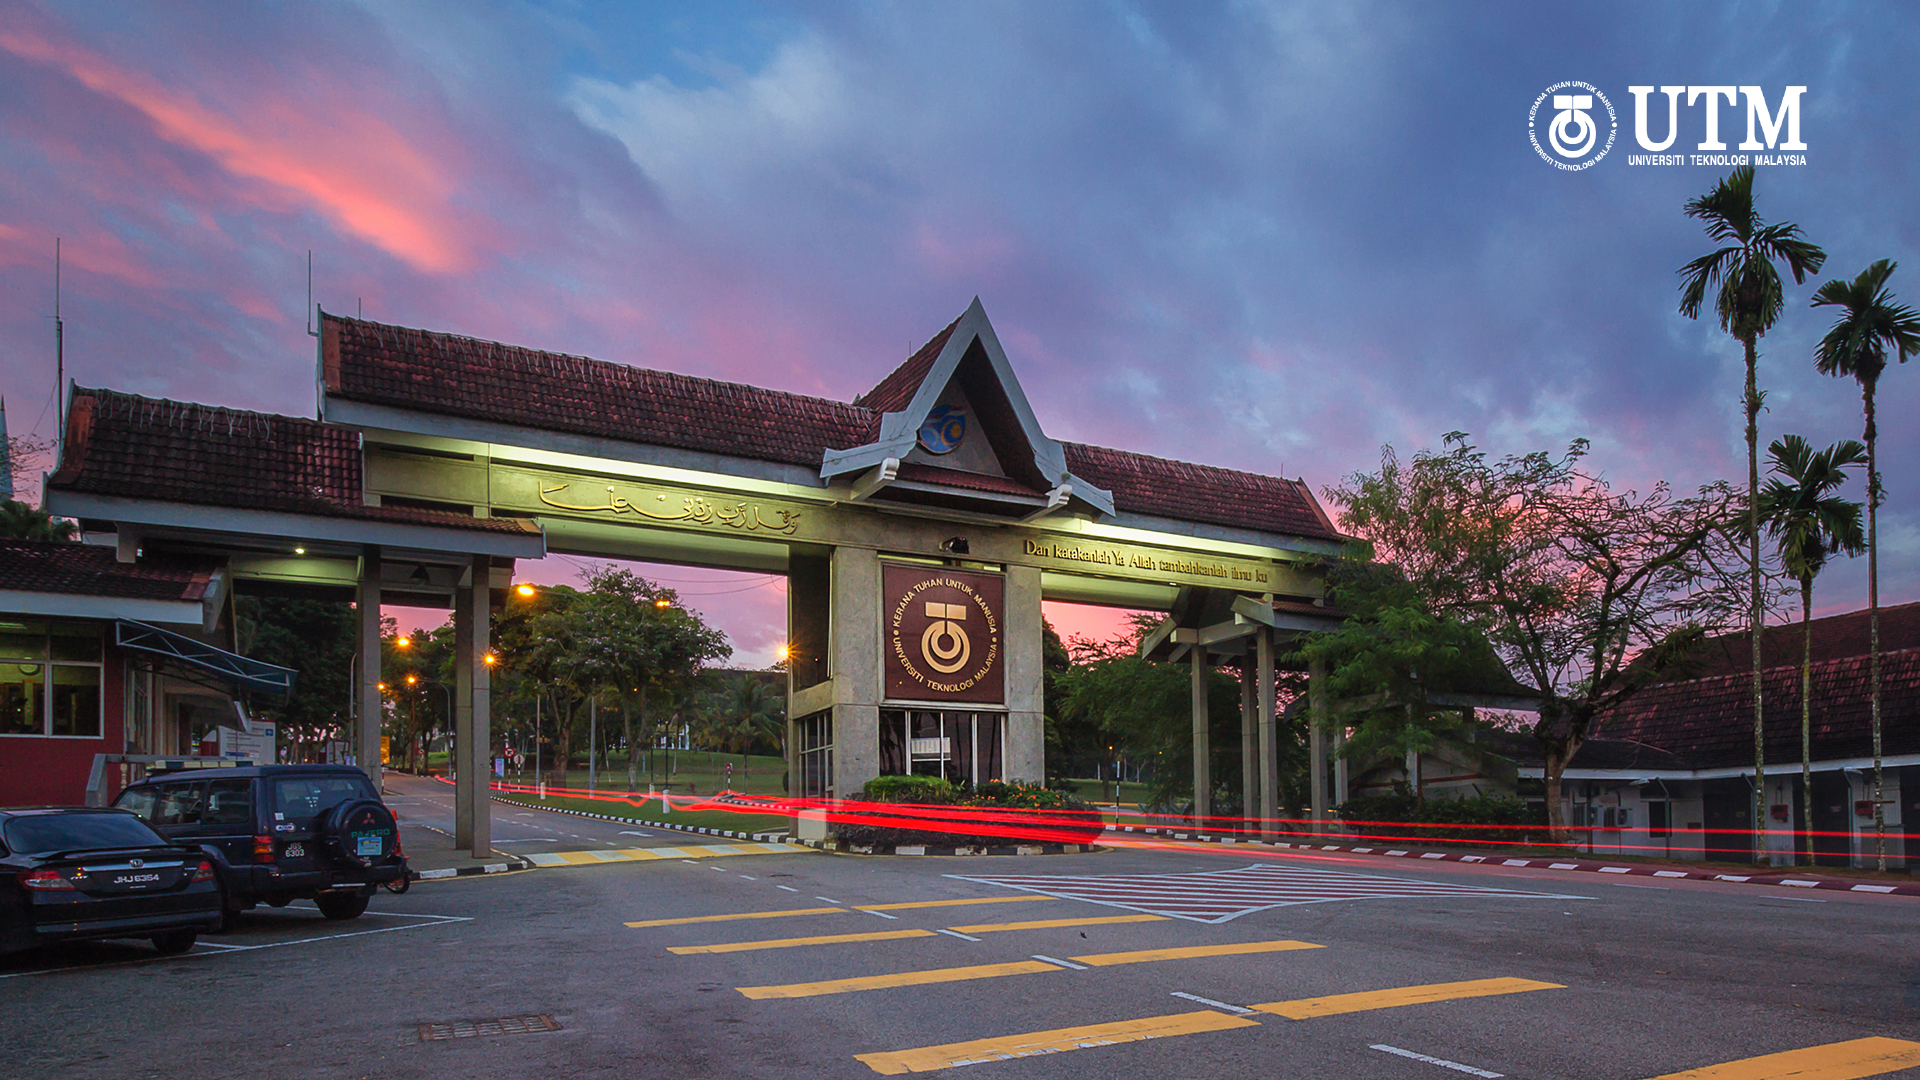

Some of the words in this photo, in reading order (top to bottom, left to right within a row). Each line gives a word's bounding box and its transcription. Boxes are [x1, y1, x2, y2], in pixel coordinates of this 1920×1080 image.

[1026, 540, 1050, 557] Dan
[1054, 545, 1112, 565] katakanlah
[1112, 550, 1125, 566] Ya
[1130, 553, 1156, 571] Allah
[1159, 559, 1228, 578] tambahkanlah
[1231, 566, 1252, 581] ilmu
[1255, 569, 1268, 583] ku
[892, 591, 915, 628] KERANA
[913, 578, 943, 593] TUHAN
[945, 578, 973, 596] UNTUK
[973, 594, 998, 634] MANUSIA
[892, 636, 924, 683] UNIVERSITI
[927, 678, 975, 692] TEKNOLOGI
[974, 643, 998, 682] MALAYSIA
[350, 828, 391, 839] PAJERO
[285, 848, 305, 857] 6303
[113, 876, 134, 884] JHJ
[134, 873, 160, 882] 6354
